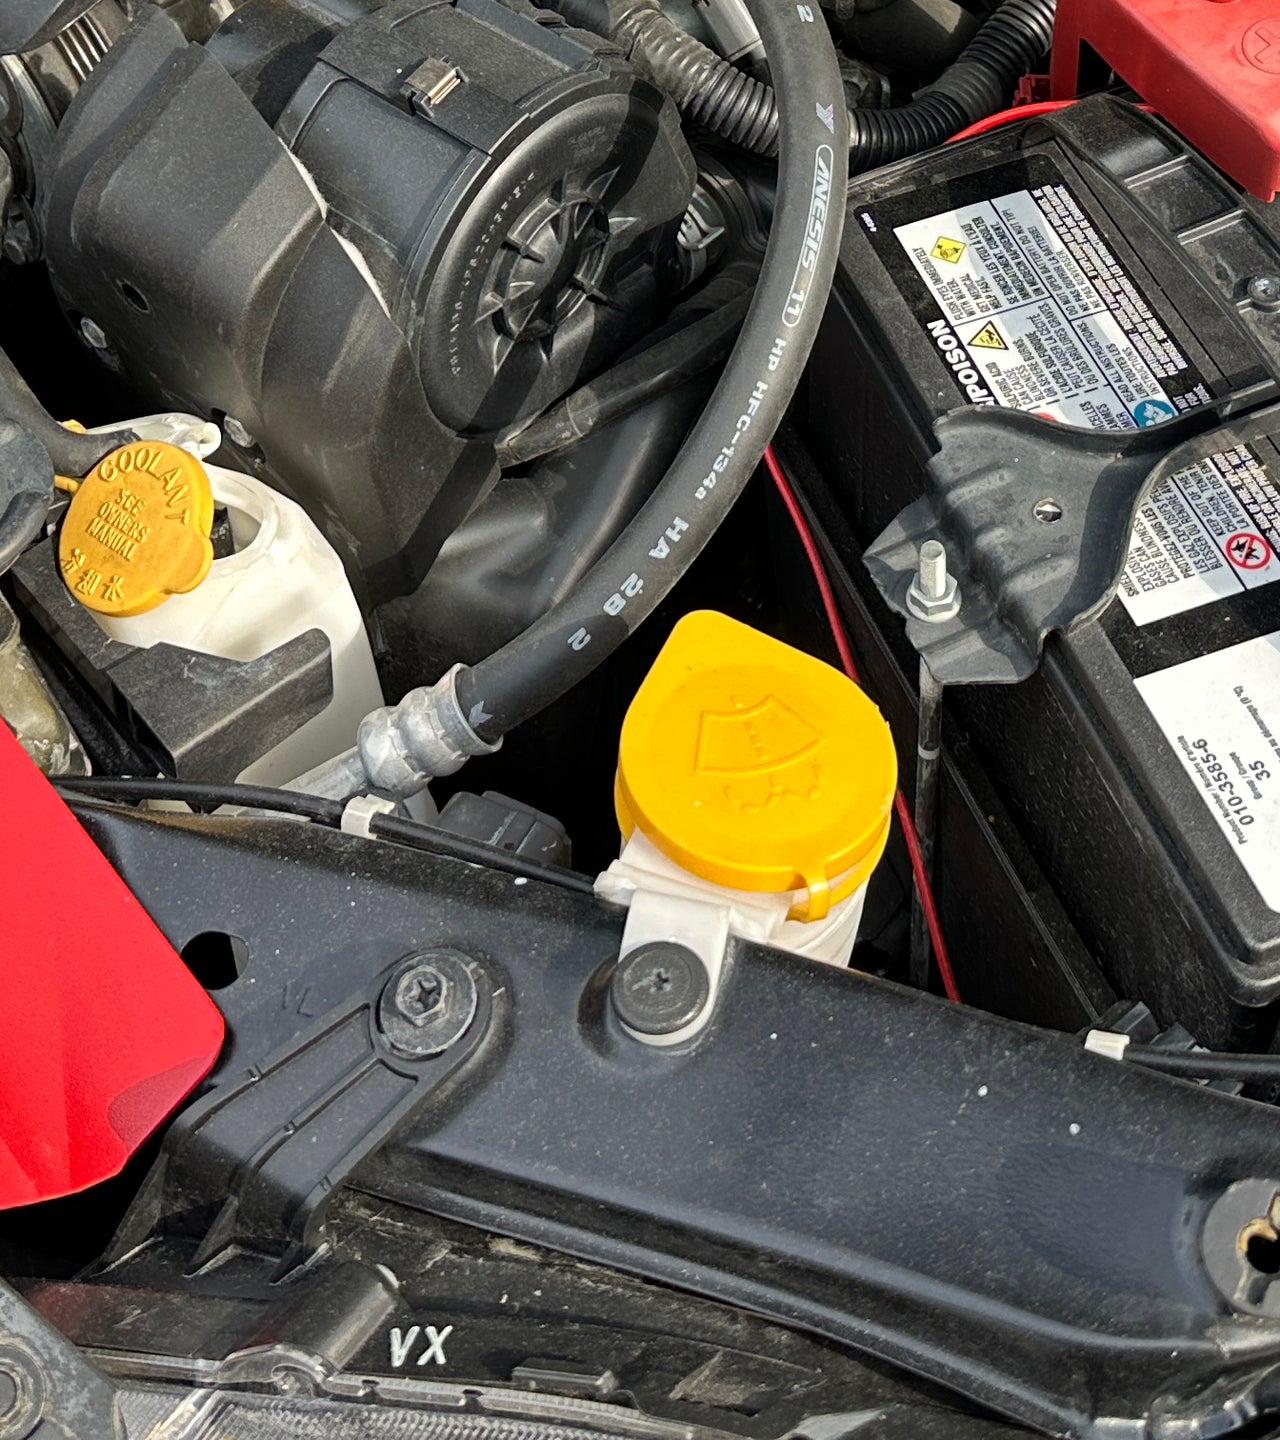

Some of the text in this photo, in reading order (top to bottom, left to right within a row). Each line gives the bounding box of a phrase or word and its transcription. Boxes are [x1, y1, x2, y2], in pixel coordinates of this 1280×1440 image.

[796, 4, 815, 23] 2
[1008, 219, 1025, 235] NOT
[1017, 234, 1032, 245] DO
[974, 244, 993, 262] YEUX
[1046, 255, 1058, 263] LA
[984, 261, 1000, 273] LES
[935, 284, 953, 301] EYES
[957, 272, 984, 301] MEDICAL
[1043, 273, 1063, 292] OPEN
[984, 293, 1002, 309] HELP
[1005, 293, 1020, 304] SE
[1068, 288, 1085, 302] PAS
[1079, 285, 1102, 309] NE PAS
[958, 299, 977, 317] WITH
[1076, 301, 1091, 312] NE
[767, 337, 787, 372] HP
[1048, 344, 1074, 372] CAUSER
[1026, 360, 1051, 386] SEVERE
[1074, 360, 1091, 374] DES
[1104, 342, 1150, 399] LIRE TOUTES LES
[1002, 367, 1034, 405] CAN CAUSE
[1013, 363, 1046, 401] BLINDNESS
[1065, 371, 1085, 388] PEUT
[1083, 373, 1098, 384] OU
[1107, 369, 1137, 403] READ ALL
[1042, 385, 1058, 397] OR
[694, 380, 769, 501] HFC-134a
[98, 446, 192, 527] COOLANT
[1176, 474, 1194, 490] THE
[1188, 470, 1211, 493] TENIR
[1205, 473, 1223, 489] DES
[114, 489, 145, 518] SEE
[1186, 489, 1201, 501] OF
[1140, 507, 1158, 522] LES
[1163, 493, 1193, 524] RENDRE
[1194, 500, 1213, 517] OUT
[1155, 502, 1191, 543] EXPLOSIFS
[1184, 523, 1201, 536] OU
[1205, 516, 1226, 537] KEEP
[1234, 516, 1250, 529] LA
[86, 517, 138, 562] MANUAL
[648, 516, 690, 560] HA
[1181, 542, 1201, 558] GAZ
[1192, 535, 1223, 569] BLESSER
[1131, 545, 1168, 587] GASES CAN
[1154, 557, 1180, 583] CAUSE
[1191, 557, 1211, 573] LES
[602, 572, 645, 617] 28
[566, 626, 593, 652] 2
[1247, 758, 1272, 782] 35
[1190, 737, 1255, 826] 010-3585-6
[390, 1326, 453, 1367] VX
